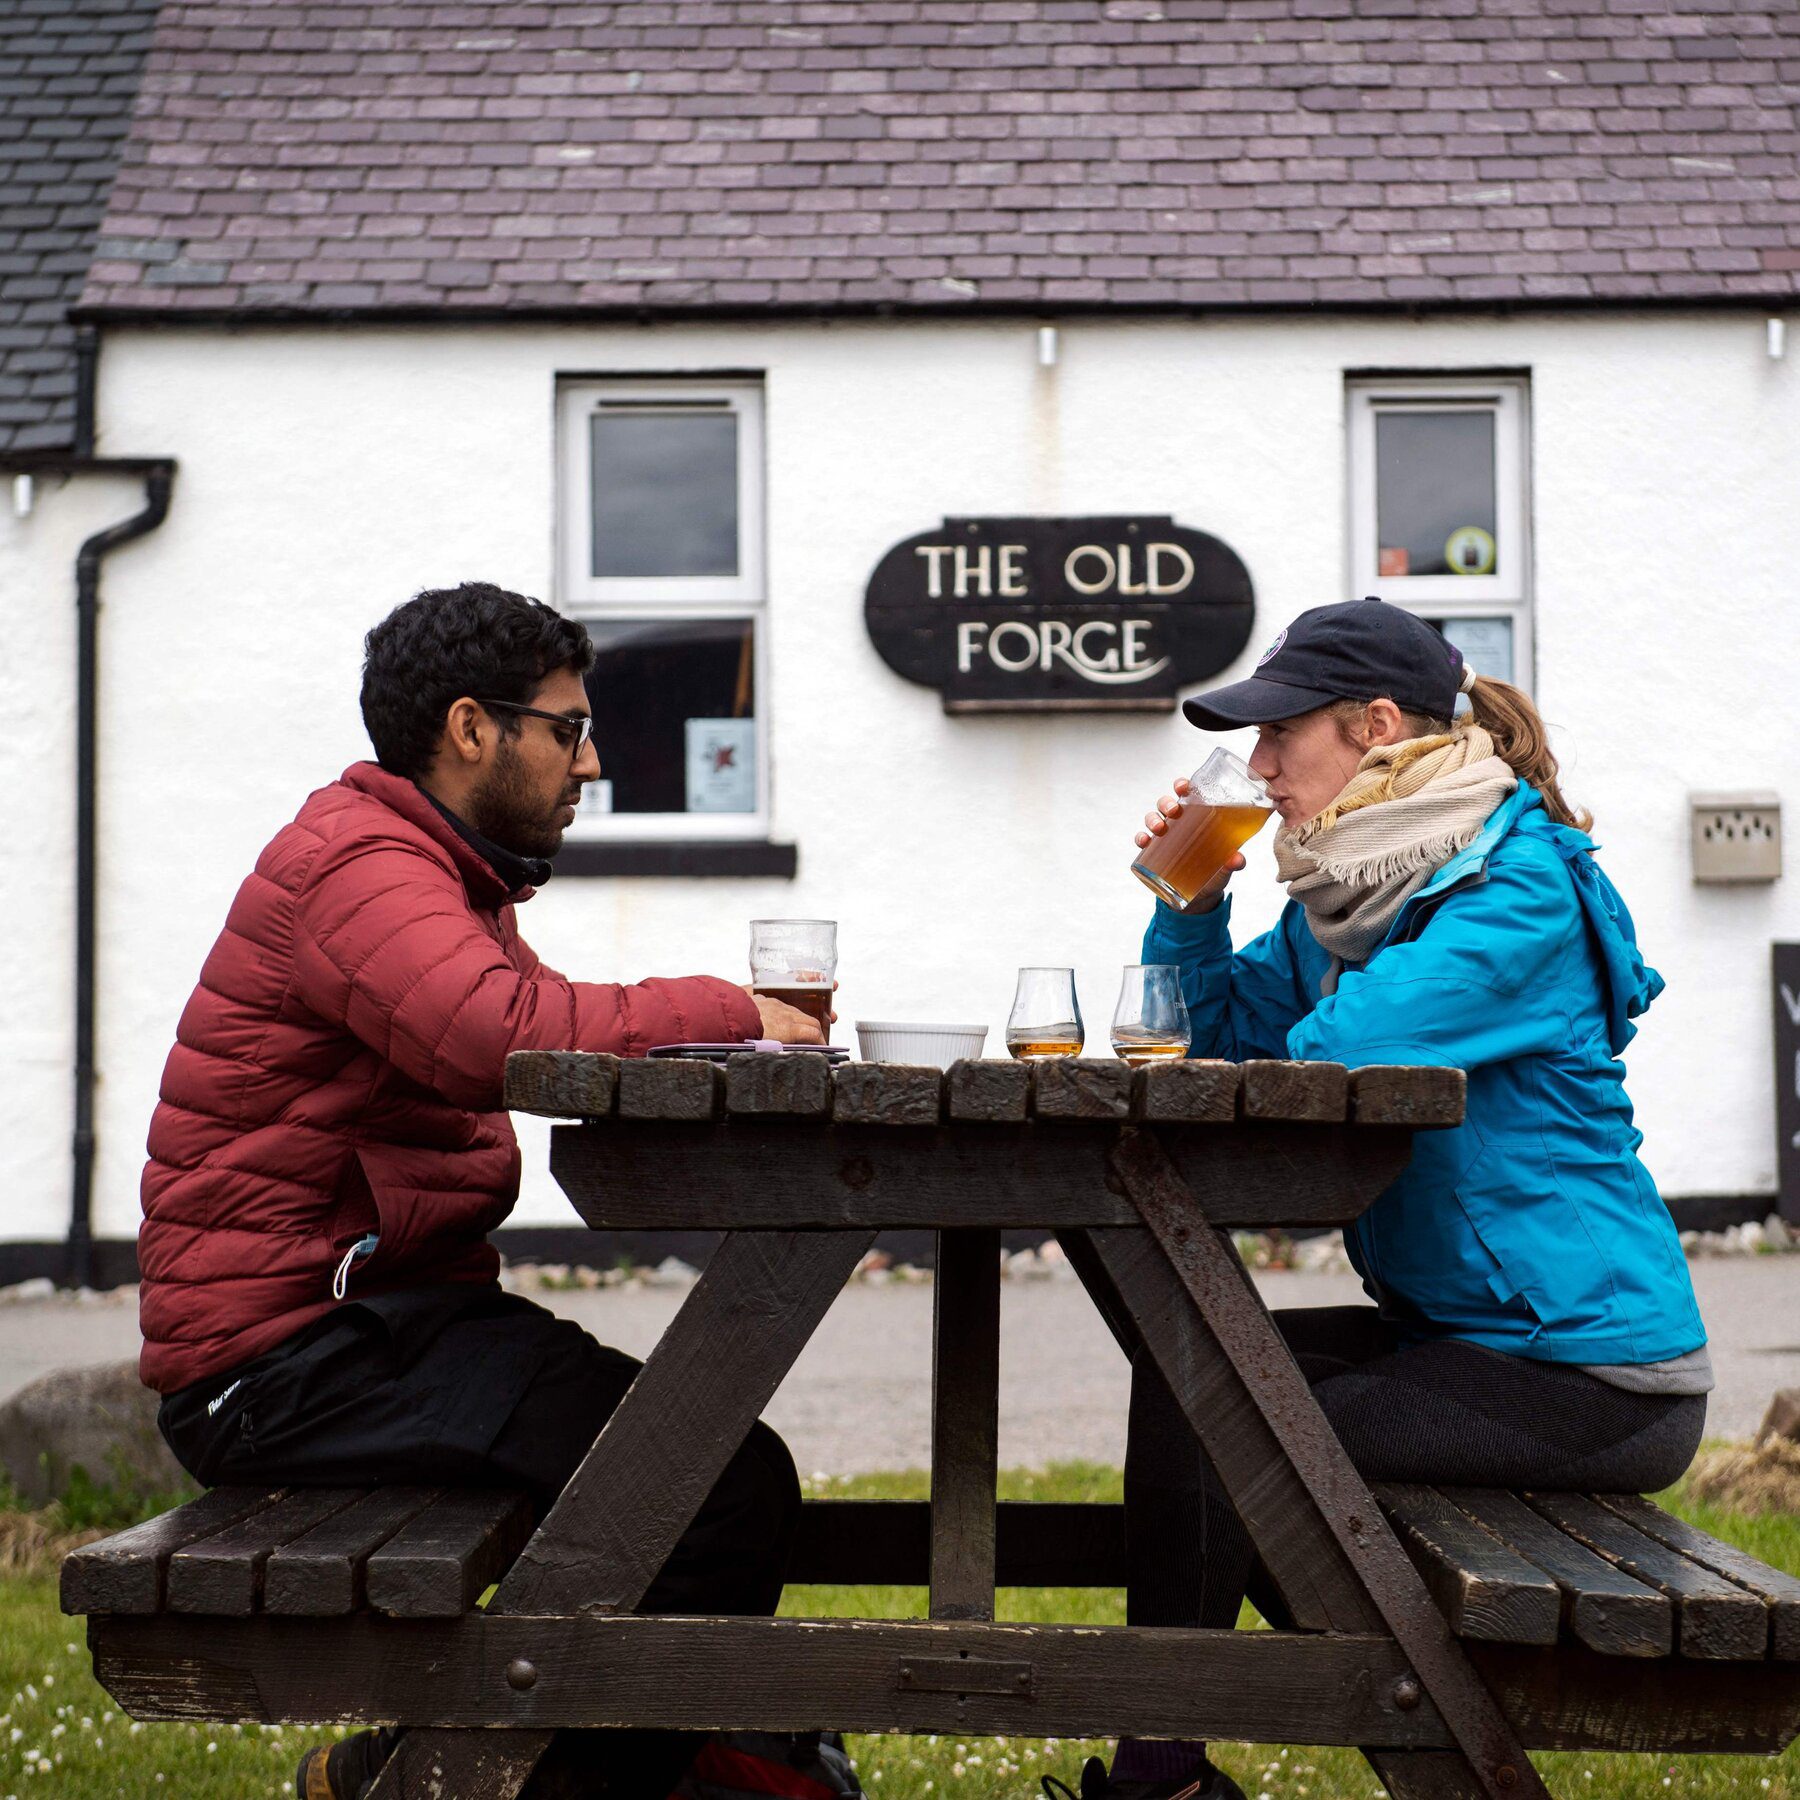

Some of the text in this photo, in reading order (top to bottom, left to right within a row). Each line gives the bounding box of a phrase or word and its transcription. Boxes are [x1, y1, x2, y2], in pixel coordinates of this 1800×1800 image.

[915, 542, 1195, 598] THE OLD
[957, 619, 1171, 685] FORGE
